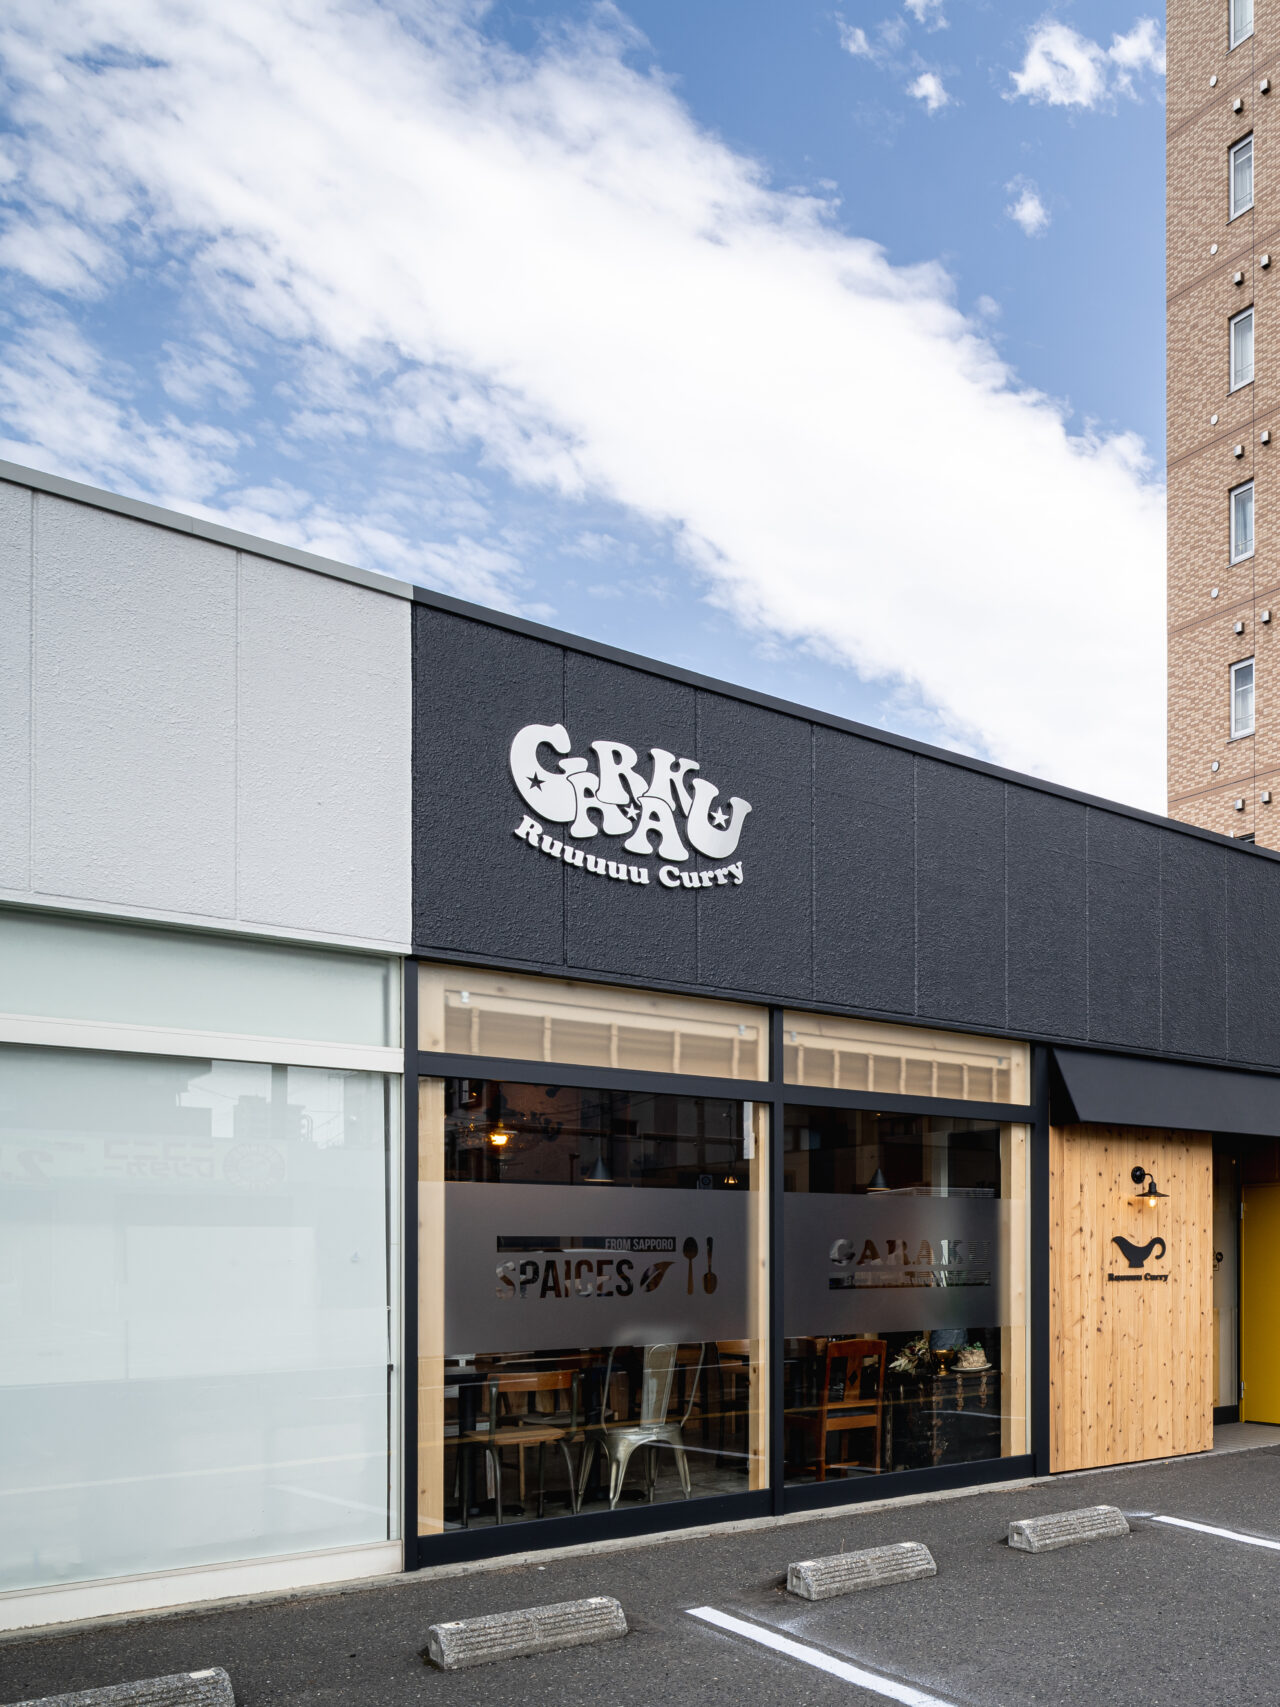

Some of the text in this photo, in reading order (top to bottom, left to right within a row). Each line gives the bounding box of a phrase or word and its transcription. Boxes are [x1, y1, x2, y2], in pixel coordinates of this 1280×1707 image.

[513, 815, 744, 888] Ruuuuu Curry
[605, 1238, 674, 1250] FROM SAPPORO
[829, 1238, 991, 1267] GARAKU
[495, 1259, 634, 1299] SPAICES
[1144, 1272, 1169, 1283] Curry
